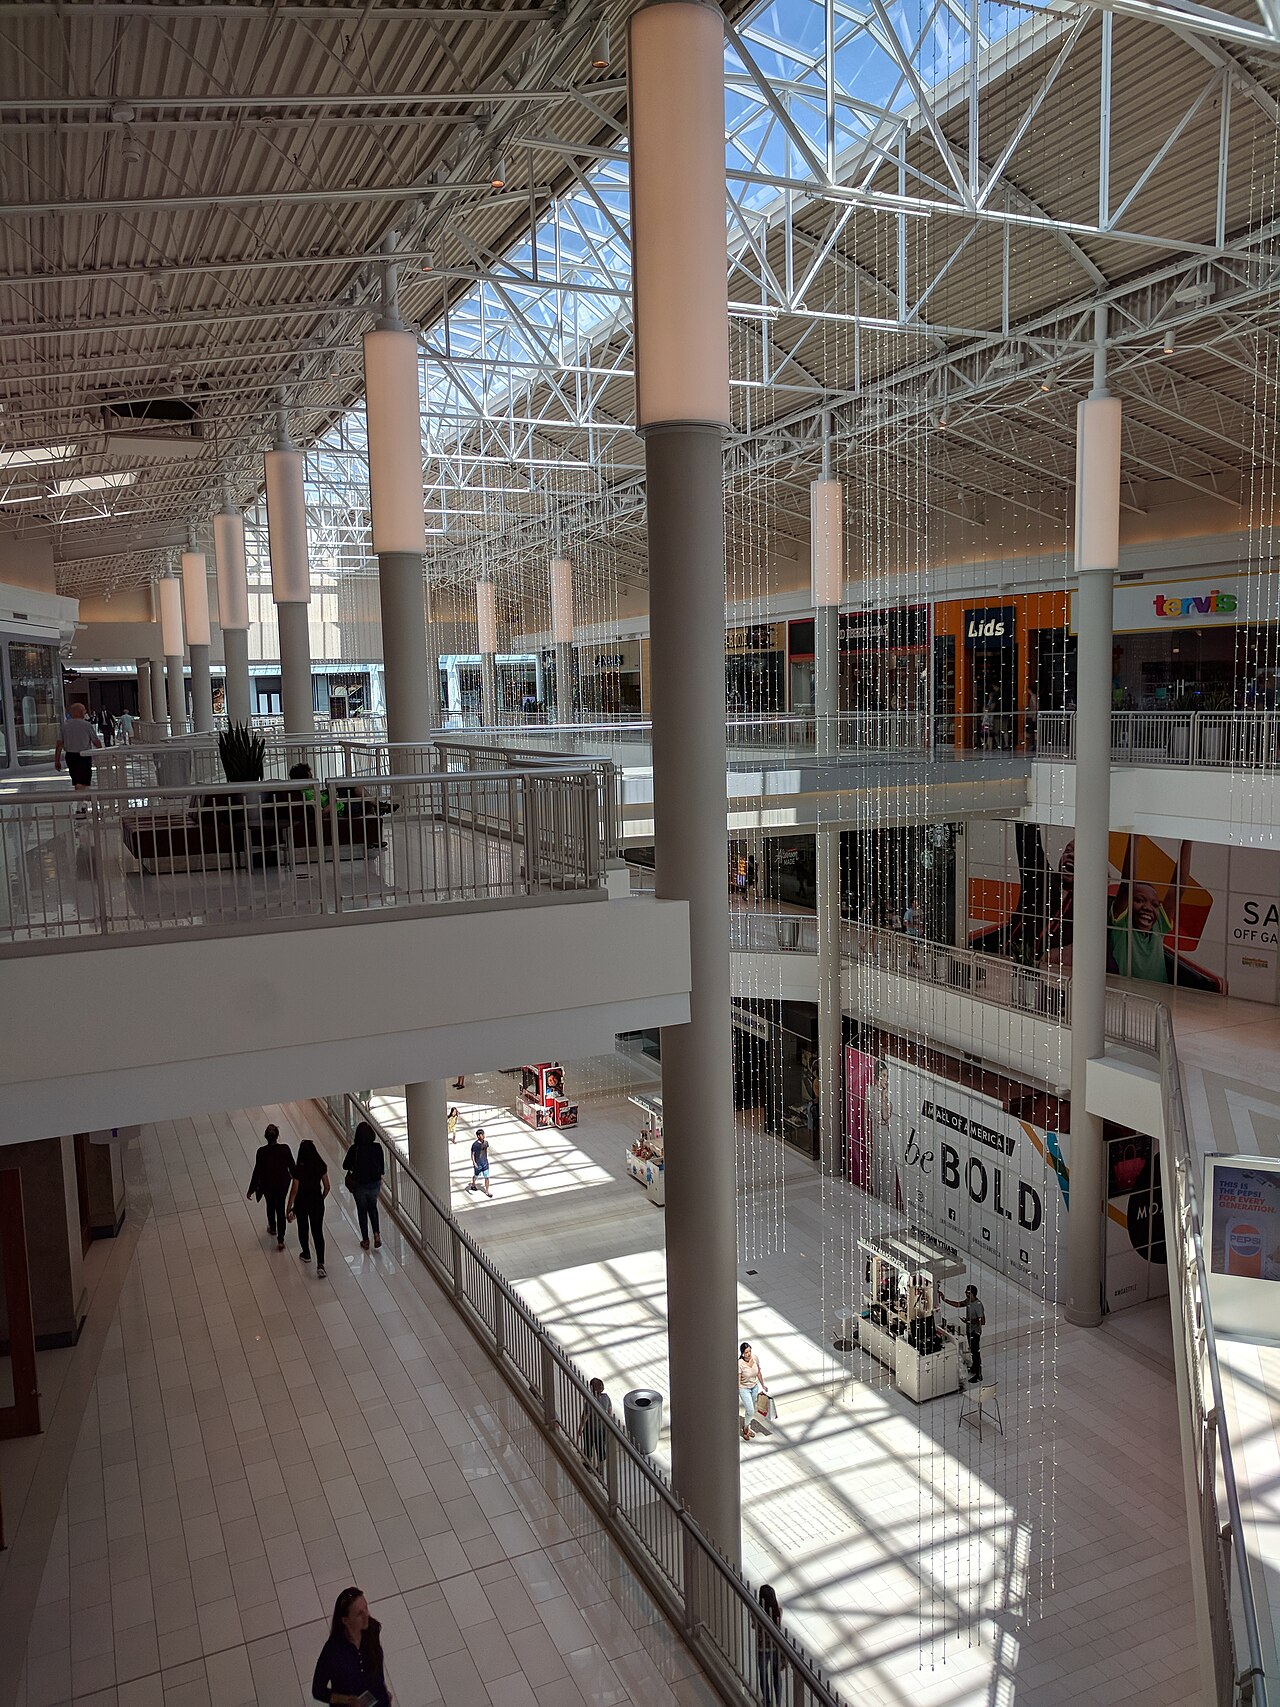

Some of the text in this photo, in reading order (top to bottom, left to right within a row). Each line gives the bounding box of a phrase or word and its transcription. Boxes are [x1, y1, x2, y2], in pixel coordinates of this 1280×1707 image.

[1153, 590, 1236, 617] tervis
[968, 618, 1004, 637] Lids
[1243, 901, 1278, 926] SA
[1234, 928, 1278, 944] OFF GA
[926, 1104, 1004, 1147] MALL OF AMERICA
[905, 1127, 1042, 1231] be BOLD
[1237, 1190, 1262, 1198] PEPSI
[1239, 1196, 1265, 1205] EVERY
[1230, 1233, 1261, 1245] PEPSI
